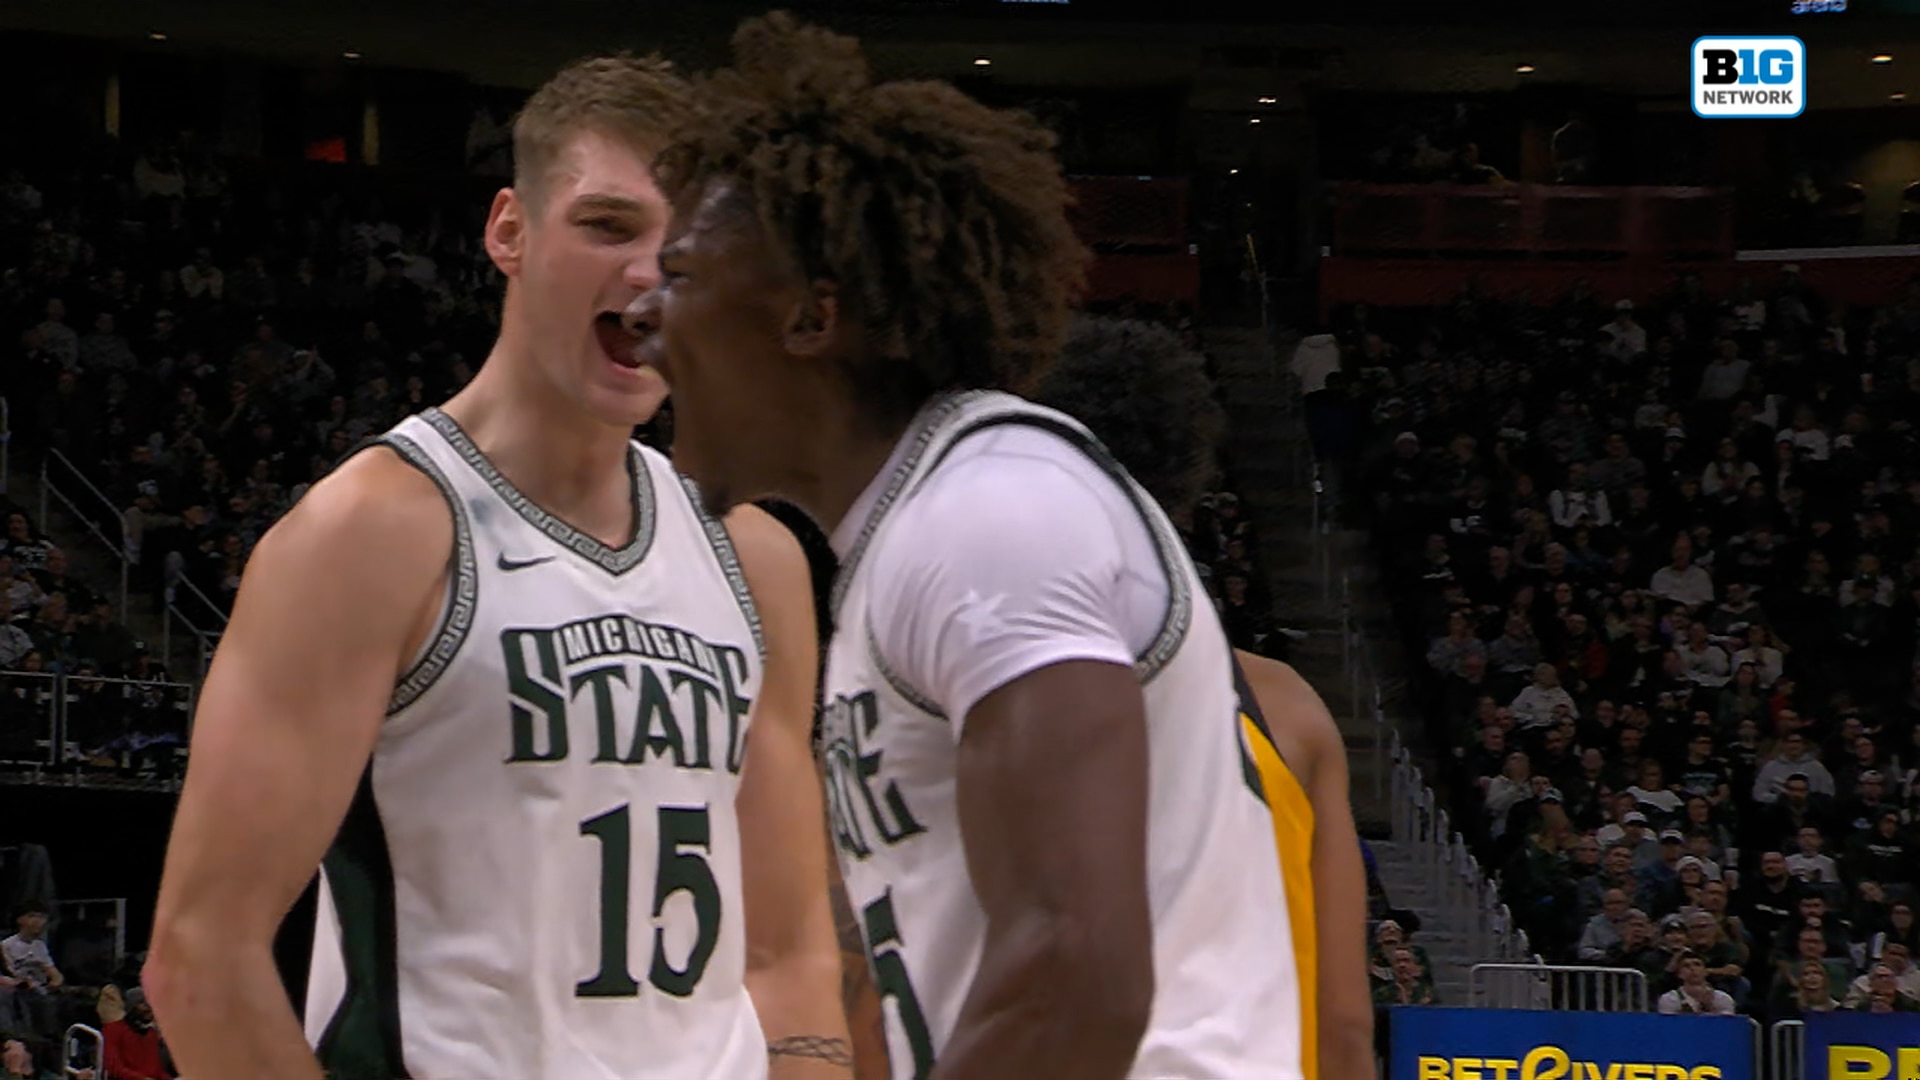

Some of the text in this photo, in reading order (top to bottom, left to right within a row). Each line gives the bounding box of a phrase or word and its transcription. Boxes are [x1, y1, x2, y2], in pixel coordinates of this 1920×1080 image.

[500, 627, 753, 776] STATE
[560, 615, 721, 680] MICHIGAN
[575, 802, 722, 998] 15
